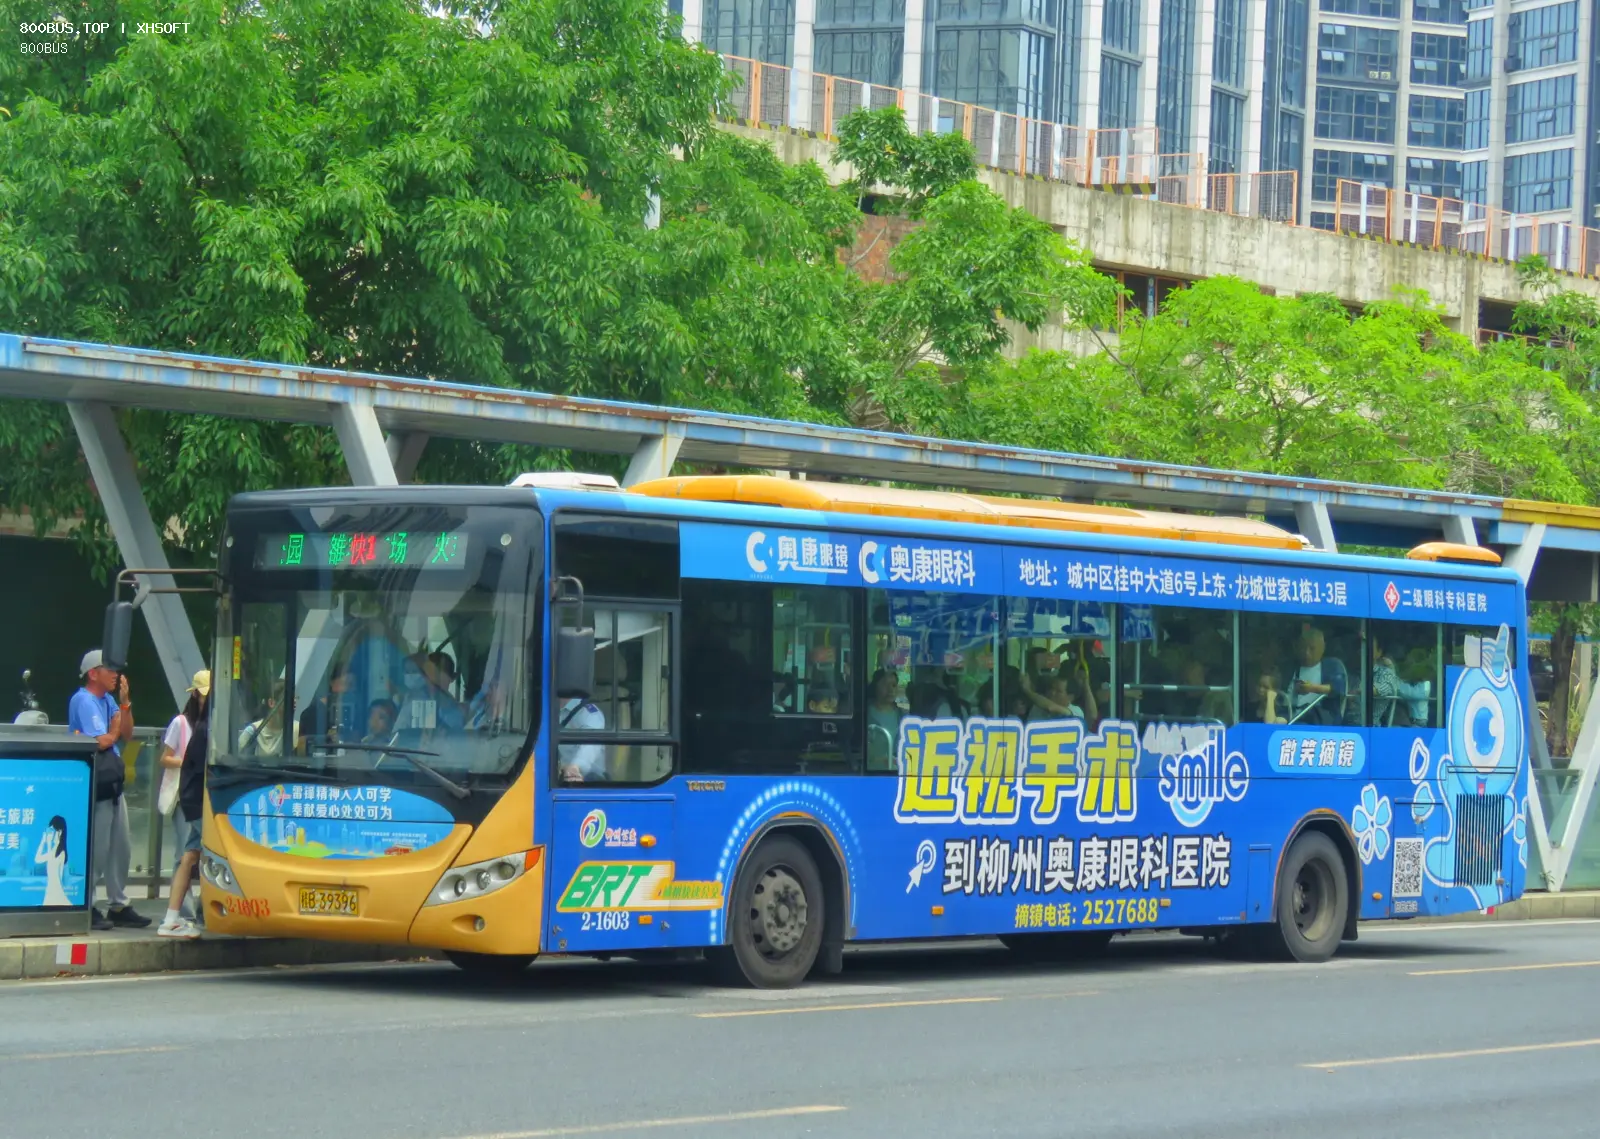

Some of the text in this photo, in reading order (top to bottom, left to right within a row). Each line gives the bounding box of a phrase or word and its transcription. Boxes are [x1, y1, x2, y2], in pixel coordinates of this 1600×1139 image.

[777, 535, 849, 573] 奥康眼镜
[890, 543, 976, 587] 奥康眼科
[1402, 588, 1488, 613] 二级眼科专科医院
[895, 717, 1140, 824] 近视手术
[1159, 725, 1250, 802] smile
[1279, 739, 1356, 769] 微笑摘镜
[292, 802, 393, 820] 奉献爱心处处可为
[942, 835, 1232, 895] 到柳州奥康眼科医院
[560, 865, 654, 908] BRT
[581, 911, 630, 931] 2-1603
